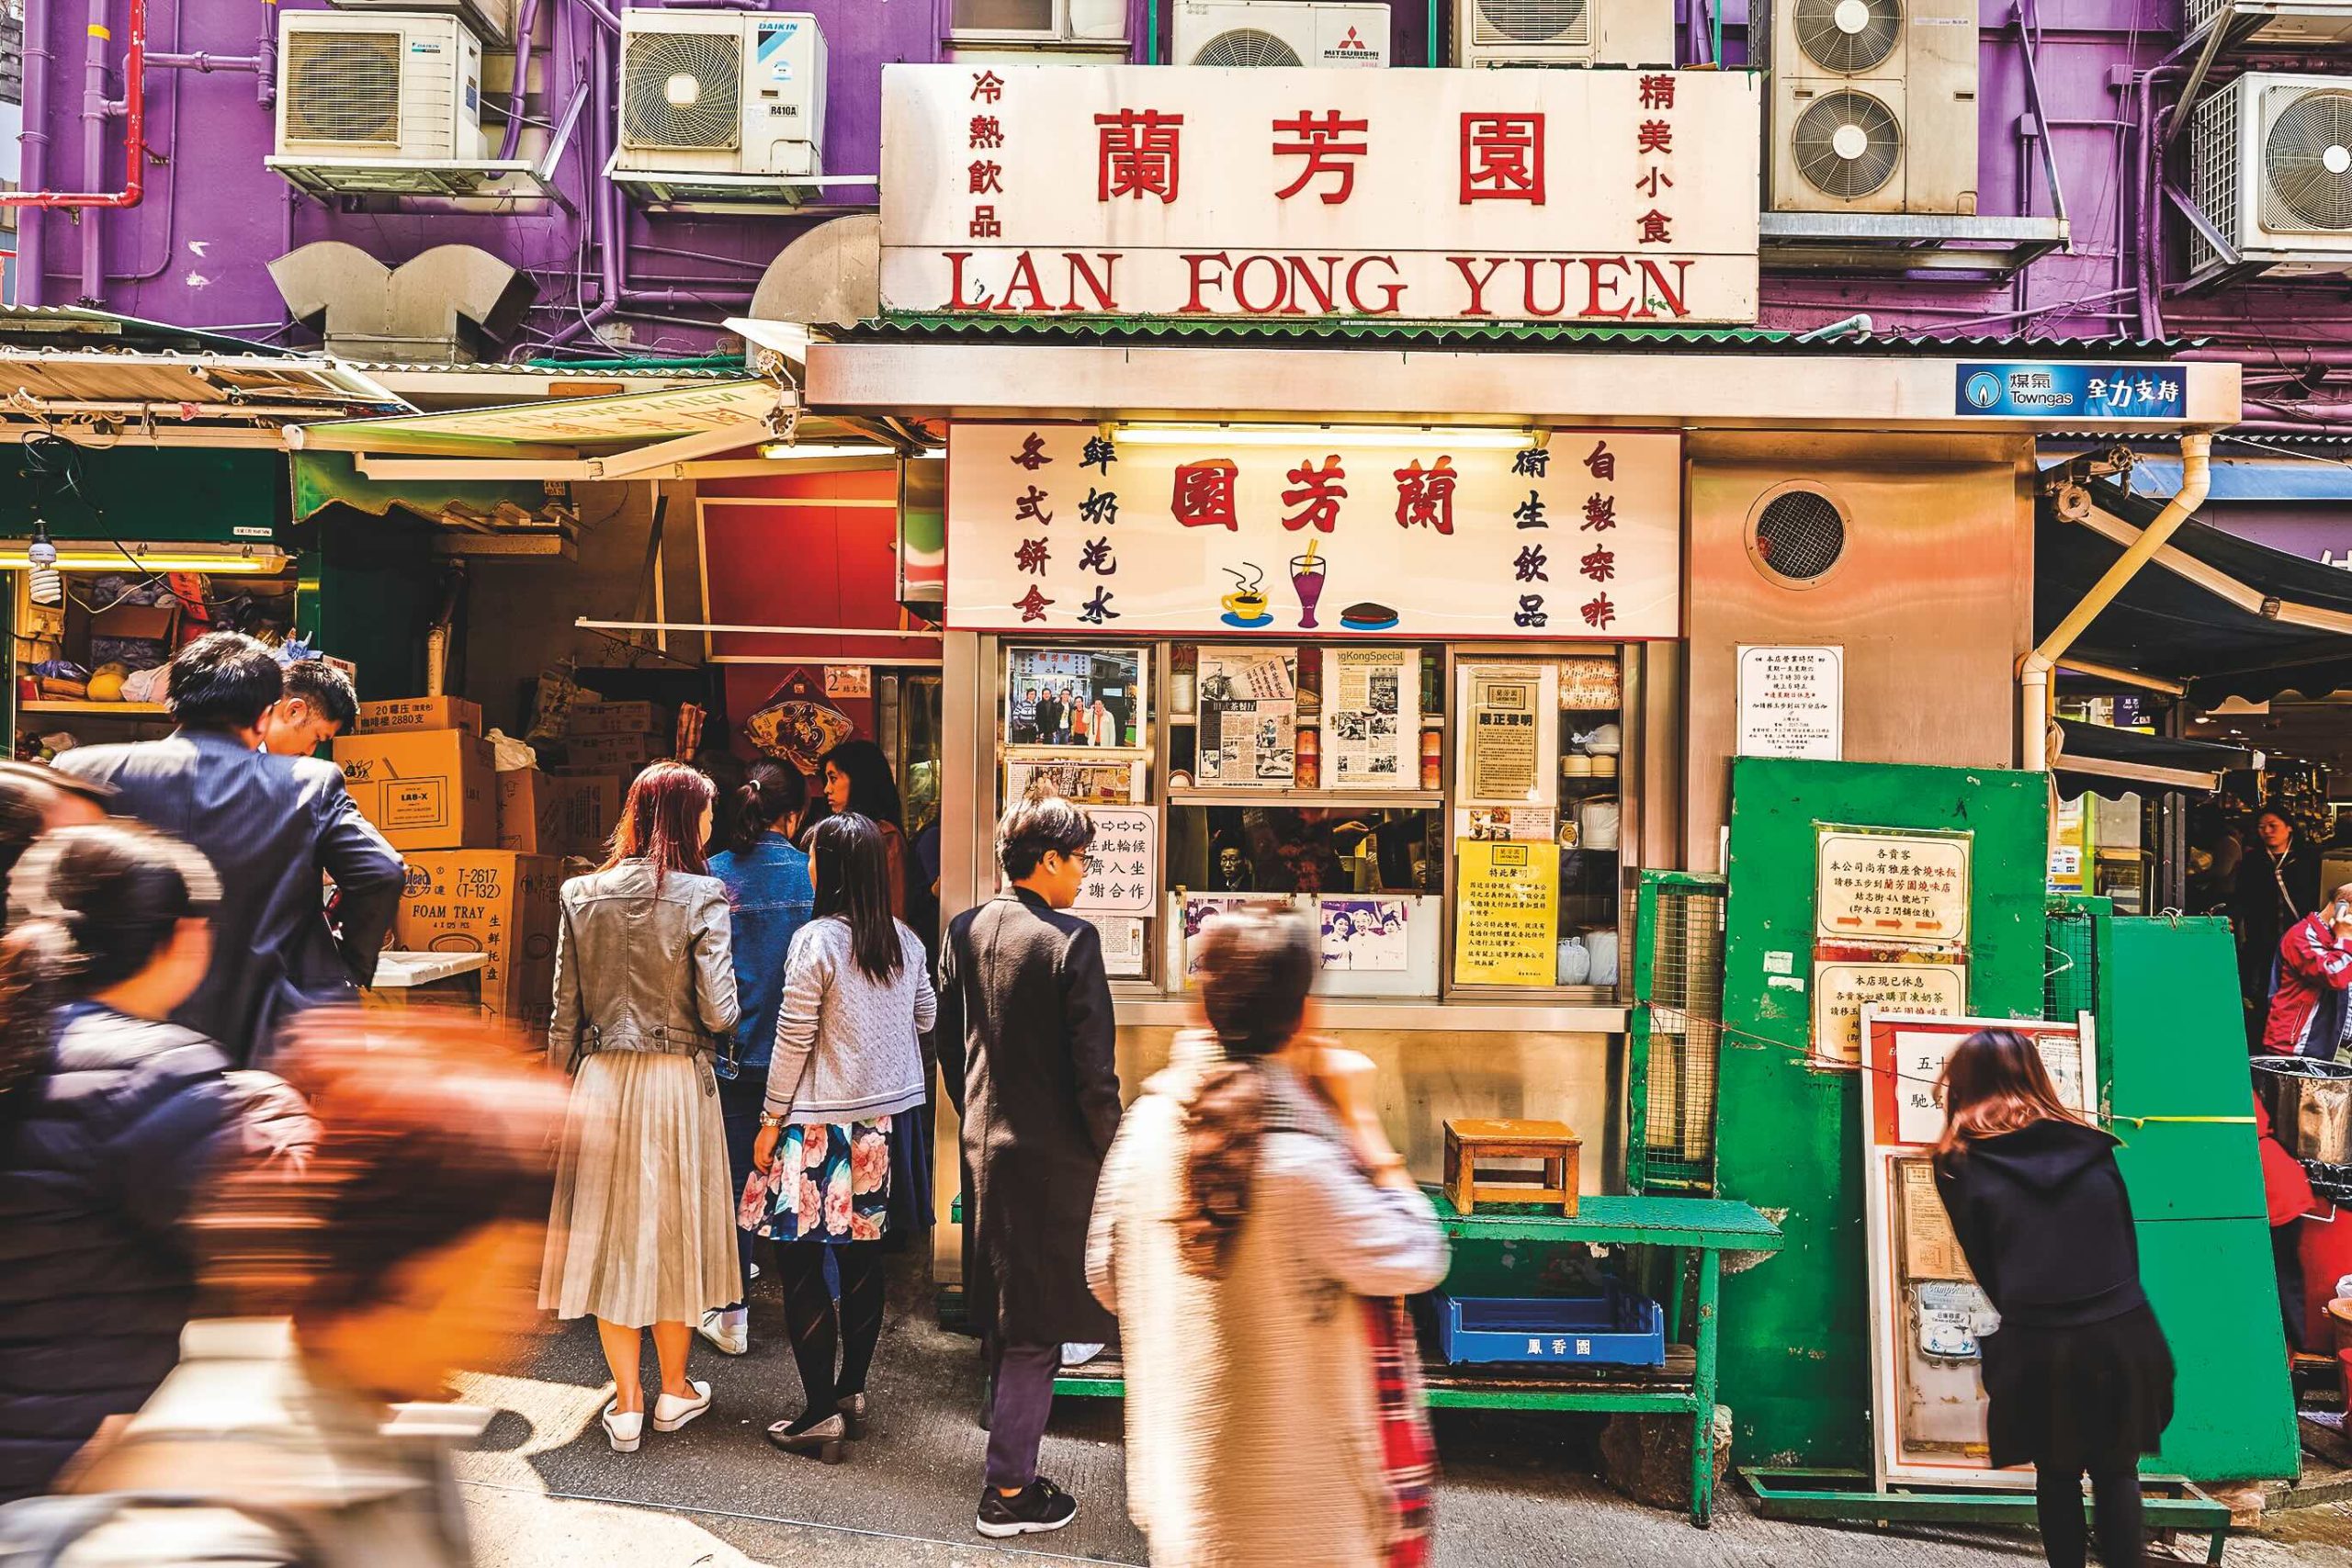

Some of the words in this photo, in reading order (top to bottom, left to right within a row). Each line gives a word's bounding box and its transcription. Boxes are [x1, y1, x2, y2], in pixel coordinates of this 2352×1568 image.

[771, 106, 797, 116] R410A
[967, 70, 1005, 238] 冷熱飲品
[1094, 108, 1545, 205] 蘭芳園
[1635, 73, 1676, 244] 精美小食
[942, 251, 1123, 311] LAN
[1180, 251, 1408, 314] FONG
[1446, 255, 1695, 321] YUEN
[2010, 374, 2052, 389] 煤氣
[2010, 390, 2074, 408] Towngas
[2087, 378, 2179, 408] 全力支持
[1011, 432, 1055, 622] 各式餅食
[1077, 436, 1121, 625] 鮮奶汽水
[1512, 447, 1550, 627] 衛生飲品
[401, 793, 428, 802] LAB-X
[1877, 849, 1911, 860] 各貴客
[458, 869, 498, 884] T-2617
[1489, 868, 1528, 878] 特此聲明
[1830, 861, 1957, 878] 本公司尚有雅座食燒味飯
[457, 884, 502, 899] (T-132)
[1834, 877, 1951, 893] 請移玉步到蘭芳園燒味店
[413, 905, 447, 918] FOAM
[454, 906, 485, 919] TRAY
[1855, 975, 1925, 987] 本店現已休息
